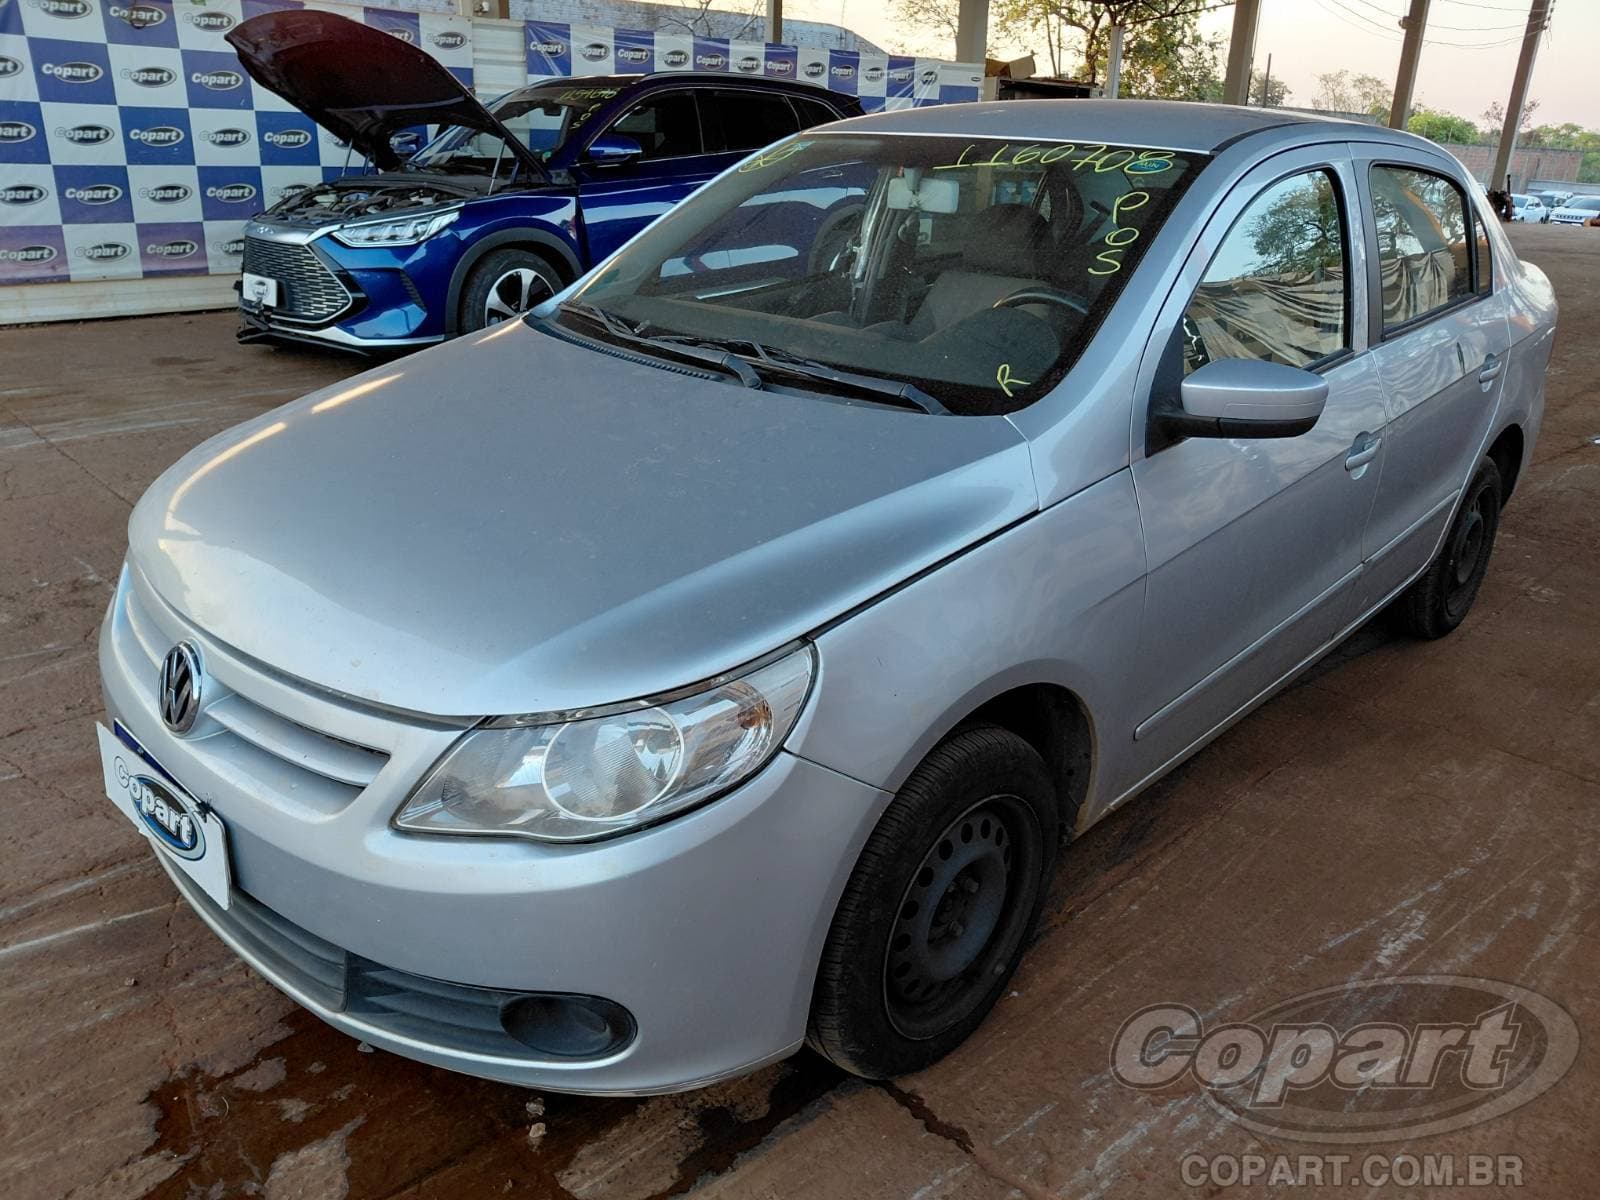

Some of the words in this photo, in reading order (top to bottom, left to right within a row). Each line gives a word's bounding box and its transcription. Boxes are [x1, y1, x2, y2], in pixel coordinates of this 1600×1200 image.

[183, 12, 229, 26] Copart
[530, 41, 562, 54] Copart
[578, 46, 605, 57] opart
[618, 49, 646, 60] Copart
[696, 55, 722, 67] Copart
[766, 61, 790, 71] Copart
[42, 63, 96, 78] Copart
[121, 68, 169, 82] Copart
[191, 72, 237, 86] Copart
[55, 127, 106, 140] Copart
[129, 129, 177, 142] Copart
[200, 131, 243, 143] Copart
[264, 131, 306, 144] Copart
[933, 144, 1176, 174] 1160708
[0, 190, 39, 201] opart
[65, 188, 114, 201] Copart
[138, 189, 185, 200] Copart
[206, 187, 250, 199] Copart
[75, 246, 124, 258] Copart
[146, 244, 192, 256] Copart
[213, 242, 244, 253] Copa
[0, 249, 50, 261] Copart
[114, 756, 194, 848] Copart
